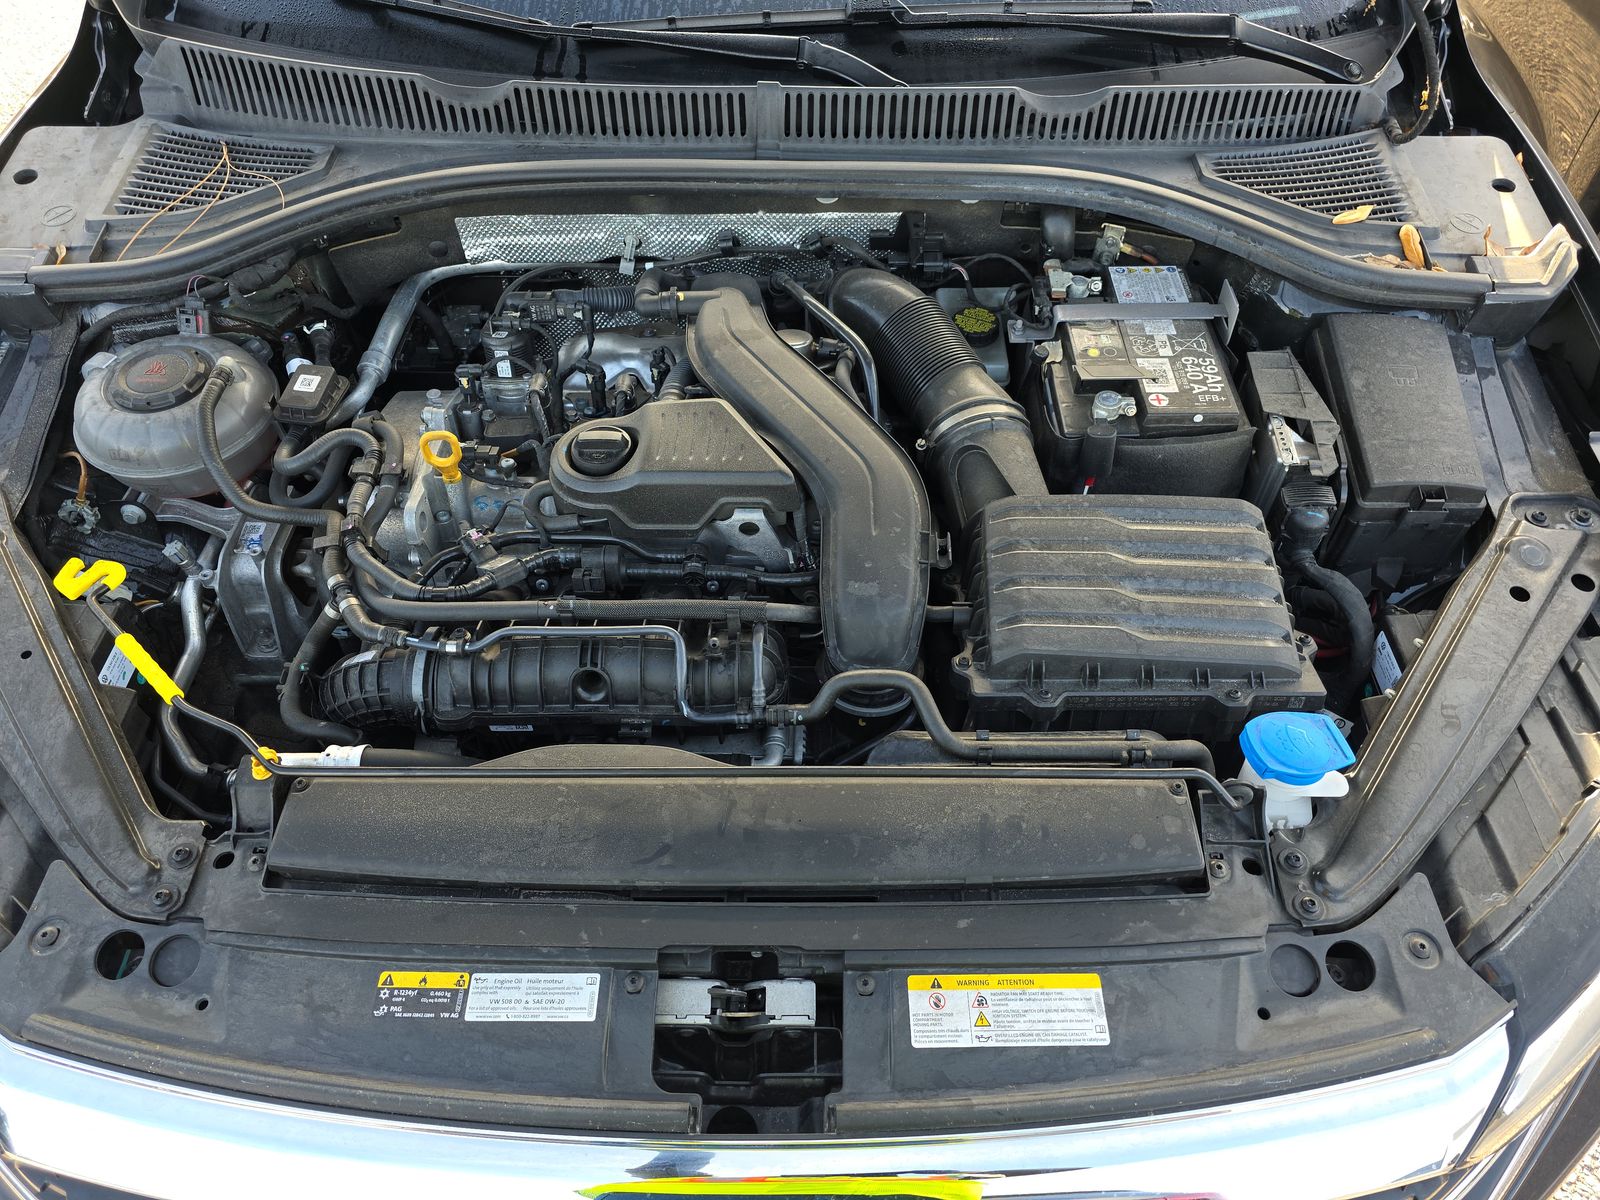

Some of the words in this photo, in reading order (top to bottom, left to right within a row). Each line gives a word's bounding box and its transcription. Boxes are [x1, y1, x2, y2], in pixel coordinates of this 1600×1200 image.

[1182, 356, 1203, 380] 640
[1198, 358, 1225, 392] 59Ah
[1190, 383, 1208, 393] A
